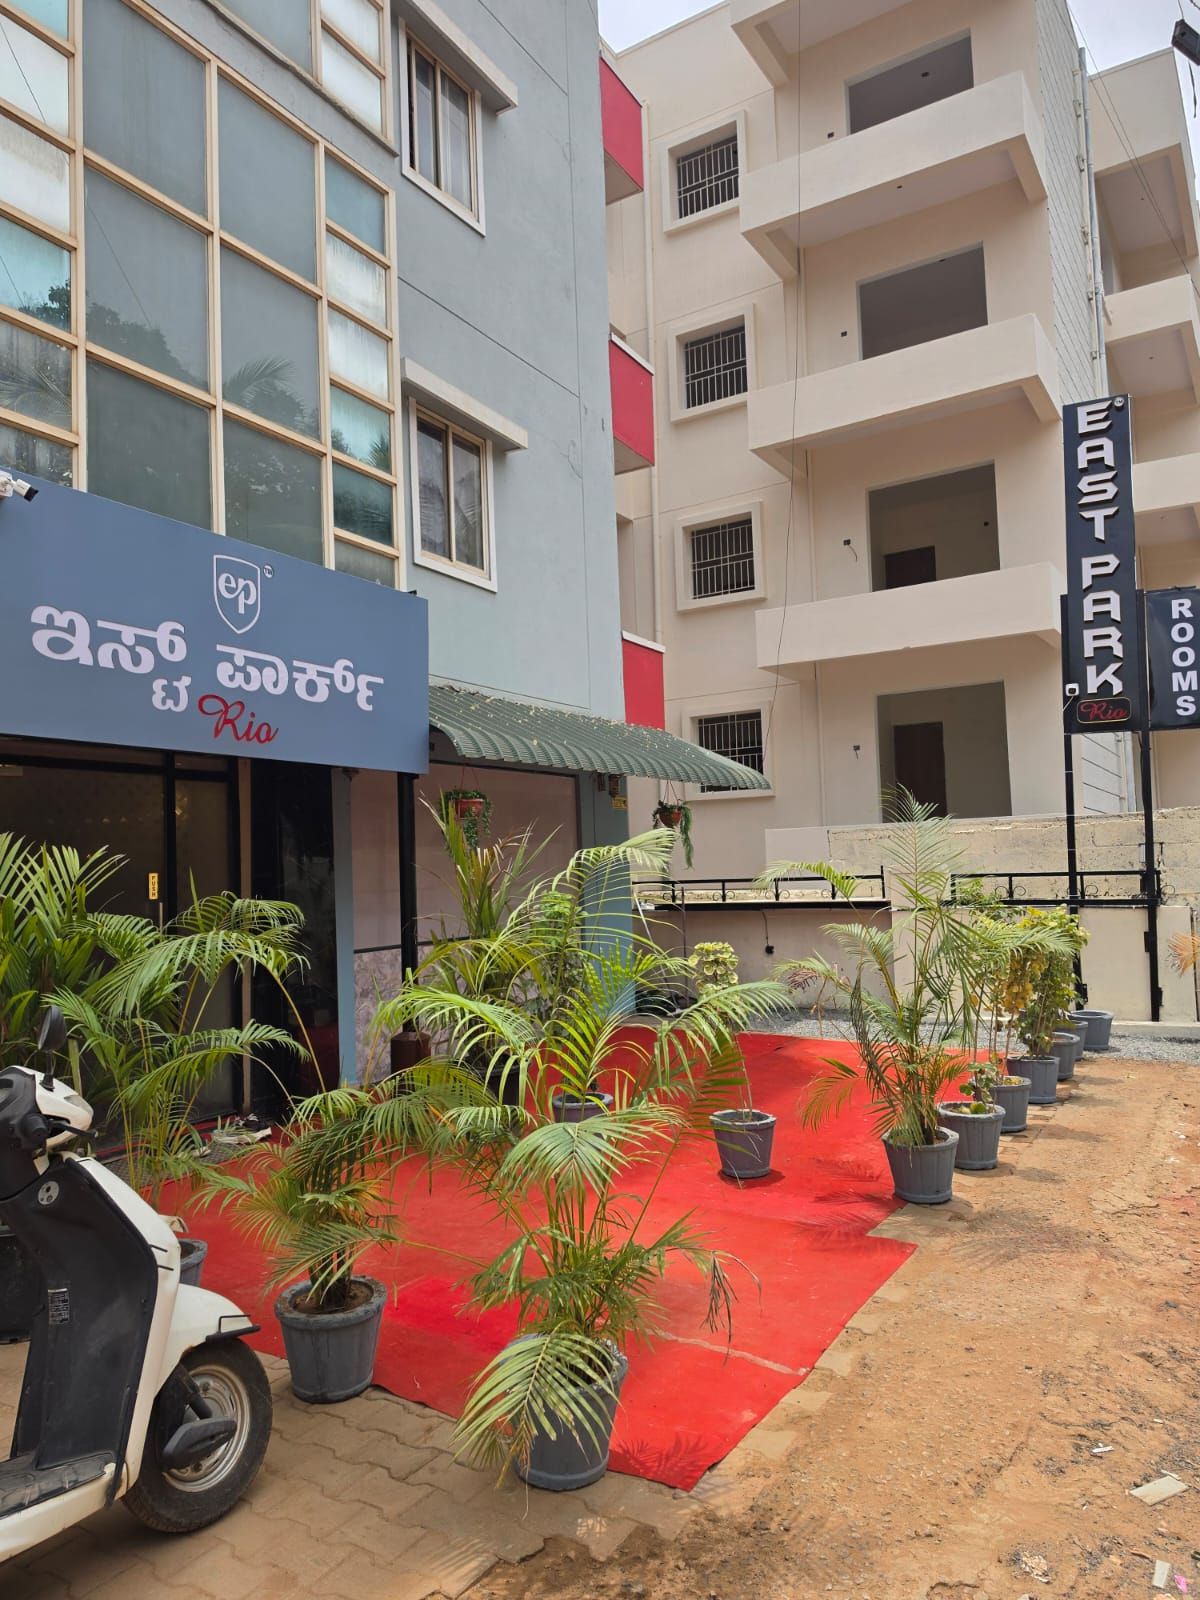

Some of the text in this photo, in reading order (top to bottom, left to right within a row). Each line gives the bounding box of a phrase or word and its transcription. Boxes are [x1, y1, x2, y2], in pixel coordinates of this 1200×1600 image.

[1077, 400, 1124, 696] EAST PARK
[1171, 598, 1198, 716] ROOMS
[198, 694, 279, 744] Rio
[1080, 702, 1127, 720] Rio
